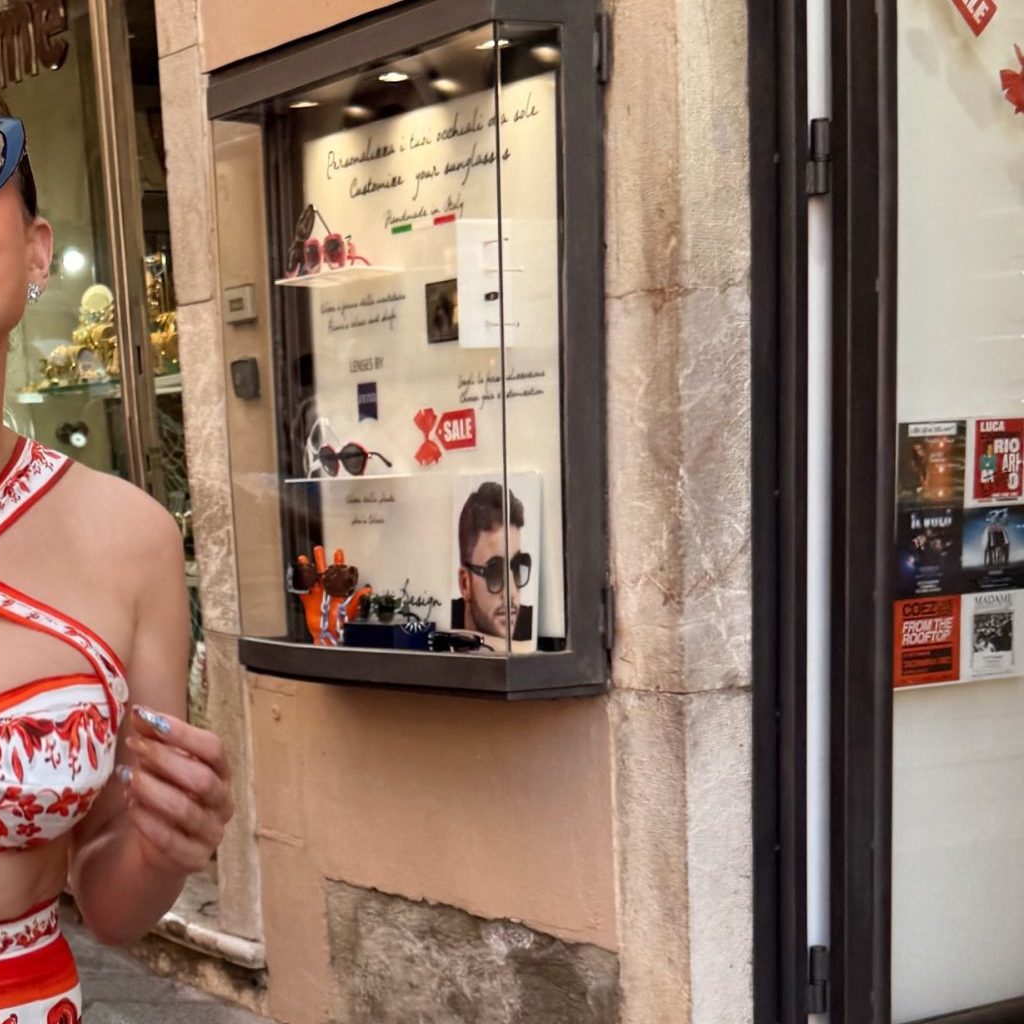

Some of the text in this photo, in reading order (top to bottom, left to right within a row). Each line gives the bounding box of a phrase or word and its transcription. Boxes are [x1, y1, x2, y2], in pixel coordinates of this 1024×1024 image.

[513, 92, 539, 123] sole
[412, 166, 441, 201] your
[444, 142, 511, 186] sunglasss
[443, 417, 473, 442] SALE
[980, 420, 1005, 432] LUCA
[994, 437, 1020, 454] RIO
[903, 619, 932, 634] FROM
[901, 629, 952, 646] ROOFTOP
